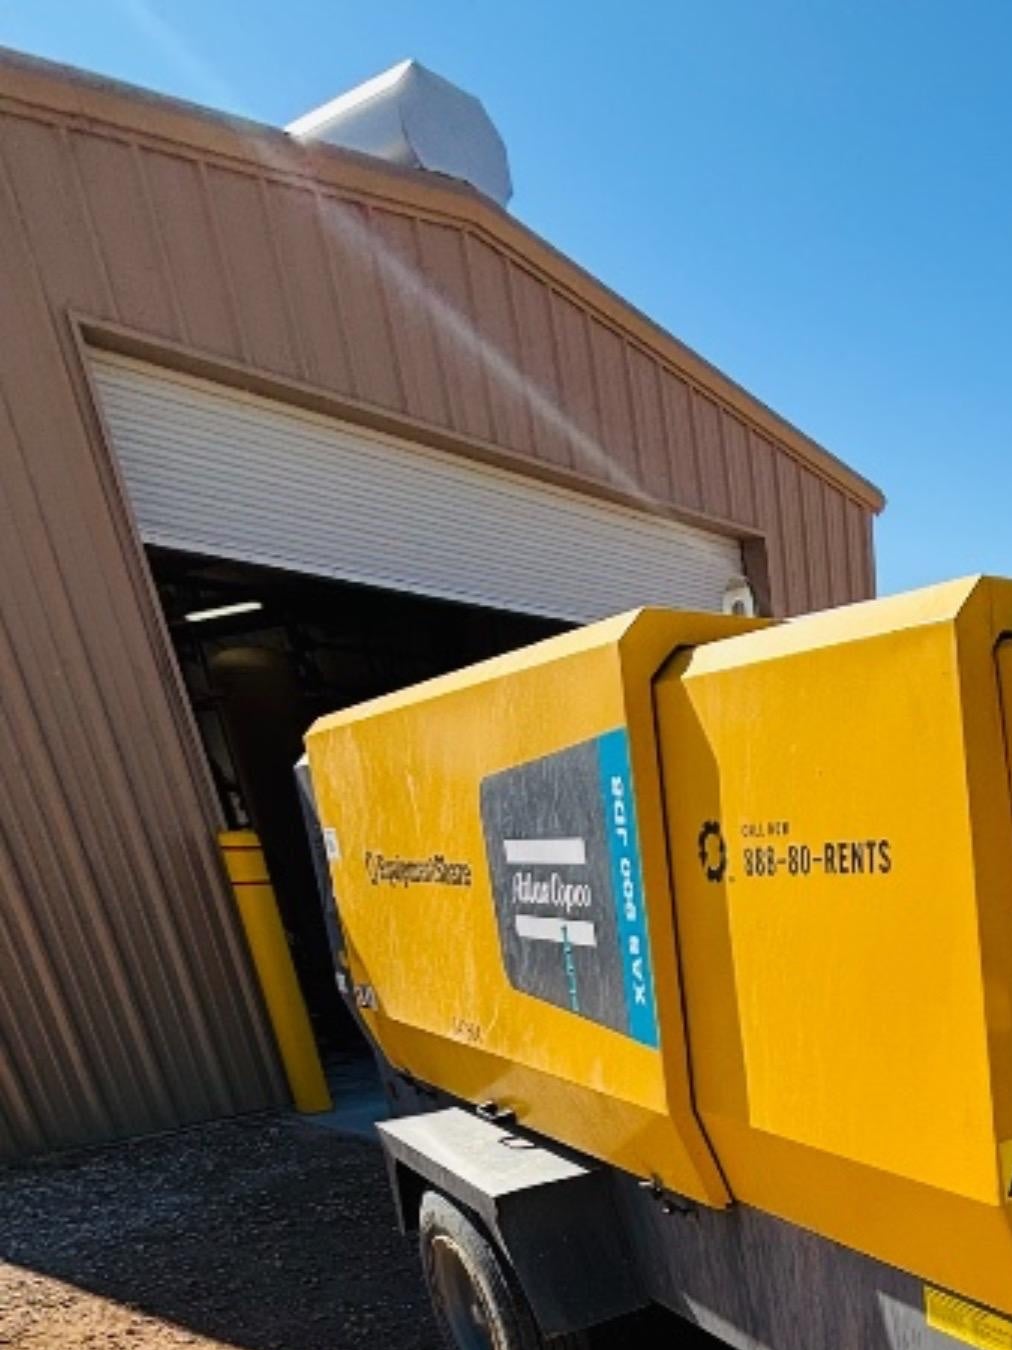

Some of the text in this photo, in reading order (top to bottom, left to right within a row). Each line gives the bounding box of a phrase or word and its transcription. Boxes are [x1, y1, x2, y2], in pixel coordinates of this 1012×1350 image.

[741, 823, 765, 838] CALL
[743, 838, 893, 877] 888-80-RENTS
[512, 871, 593, 914] Atlas Copco
